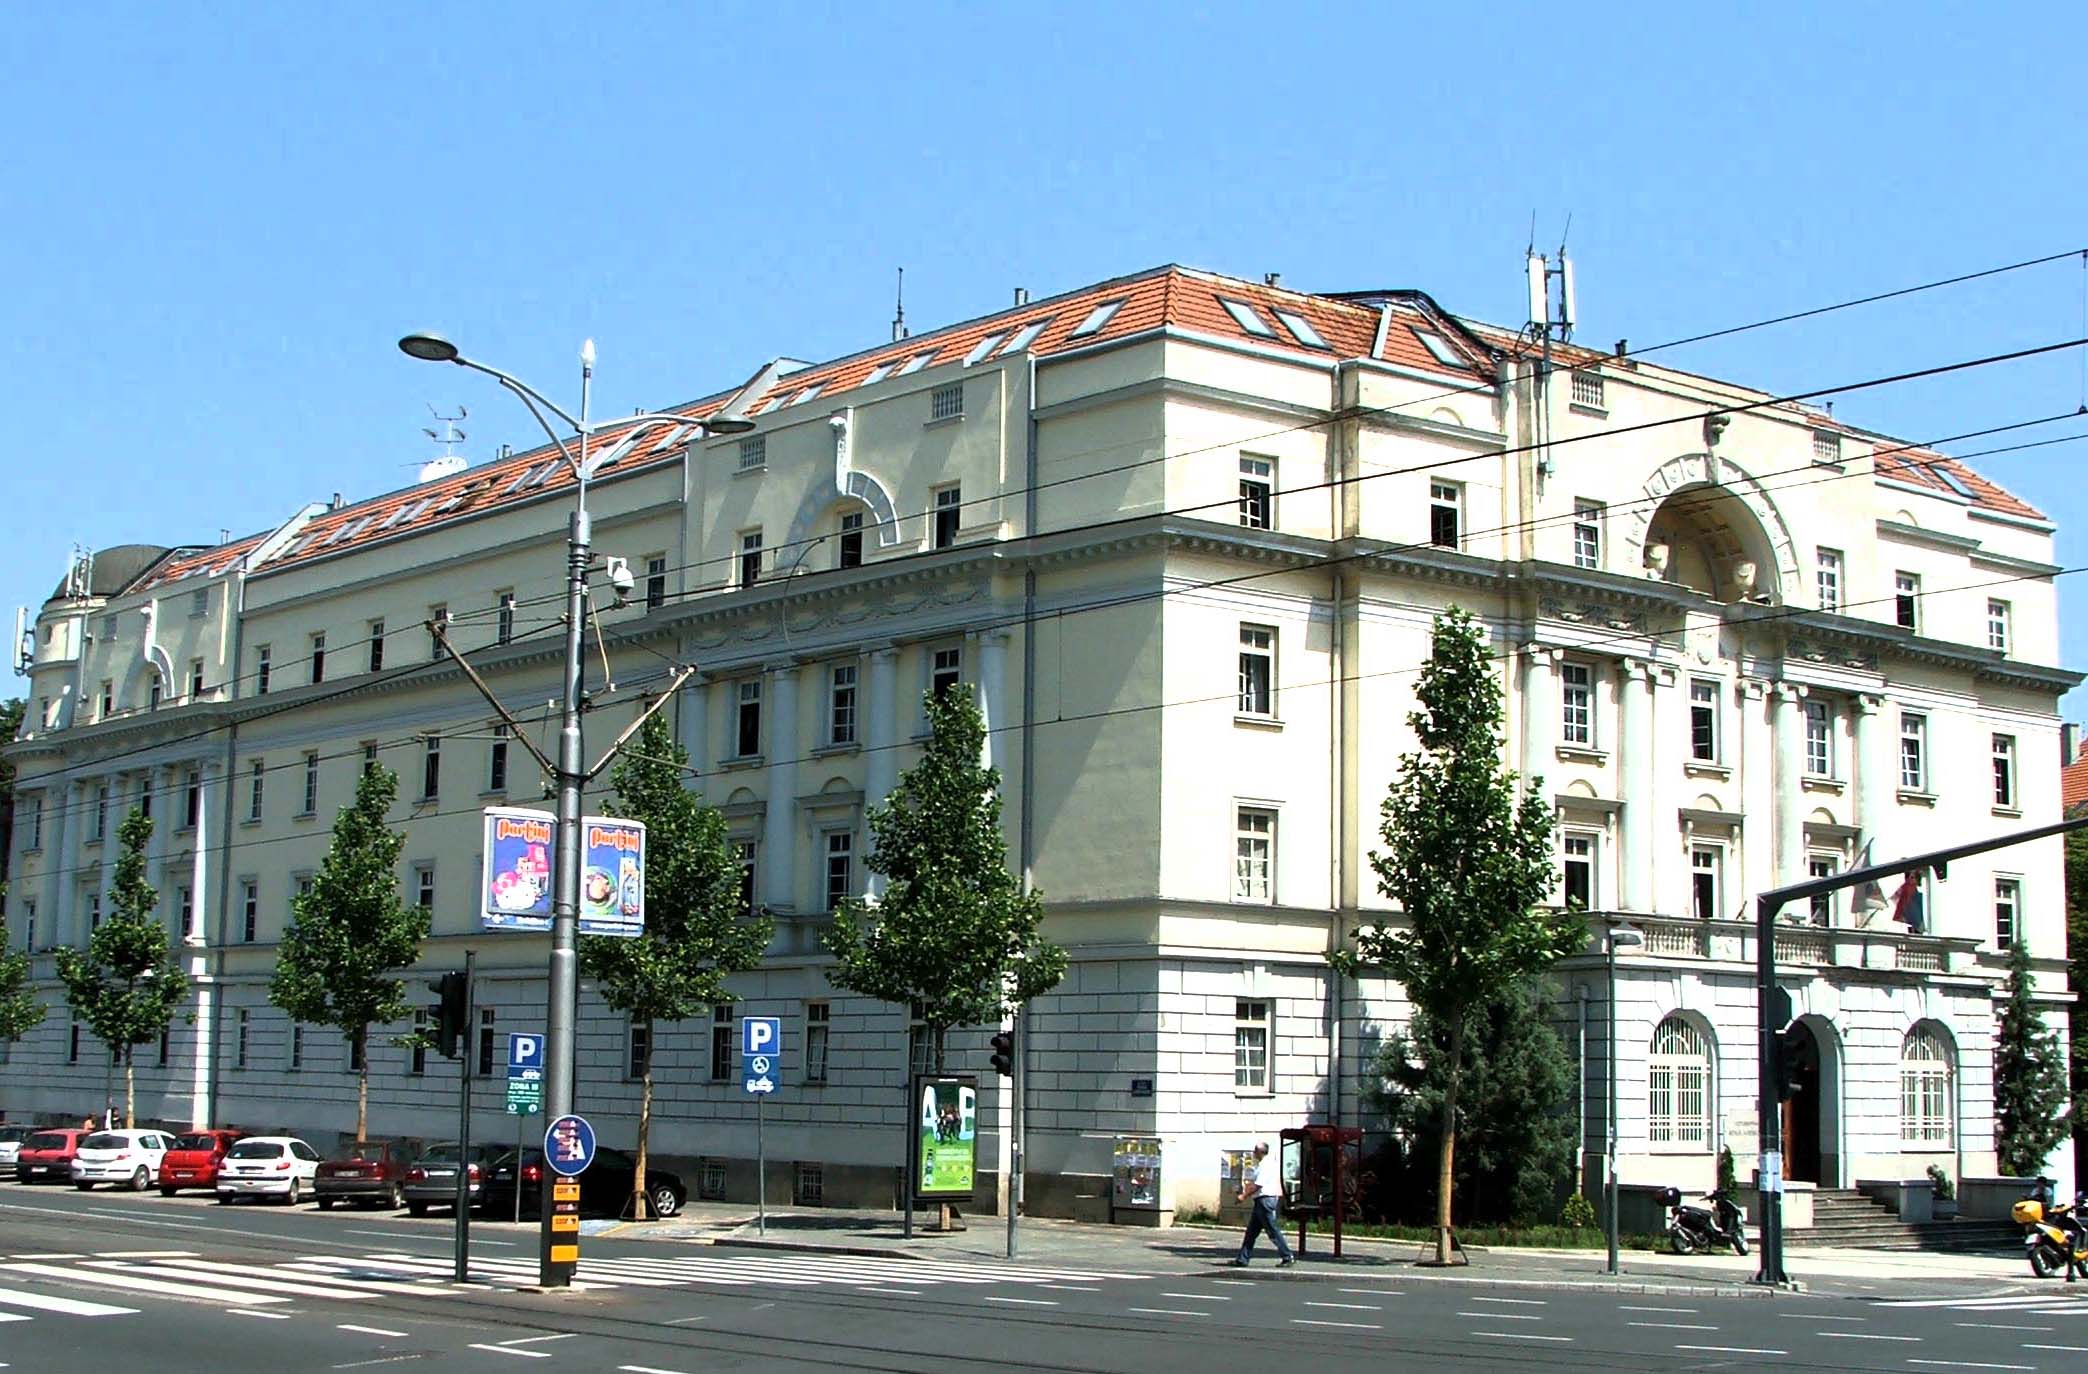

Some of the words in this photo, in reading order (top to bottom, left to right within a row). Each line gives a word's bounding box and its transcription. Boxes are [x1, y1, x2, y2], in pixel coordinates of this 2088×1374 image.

[516, 1037, 536, 1063] P
[751, 1022, 772, 1051] P
[923, 1085, 937, 1140] A
